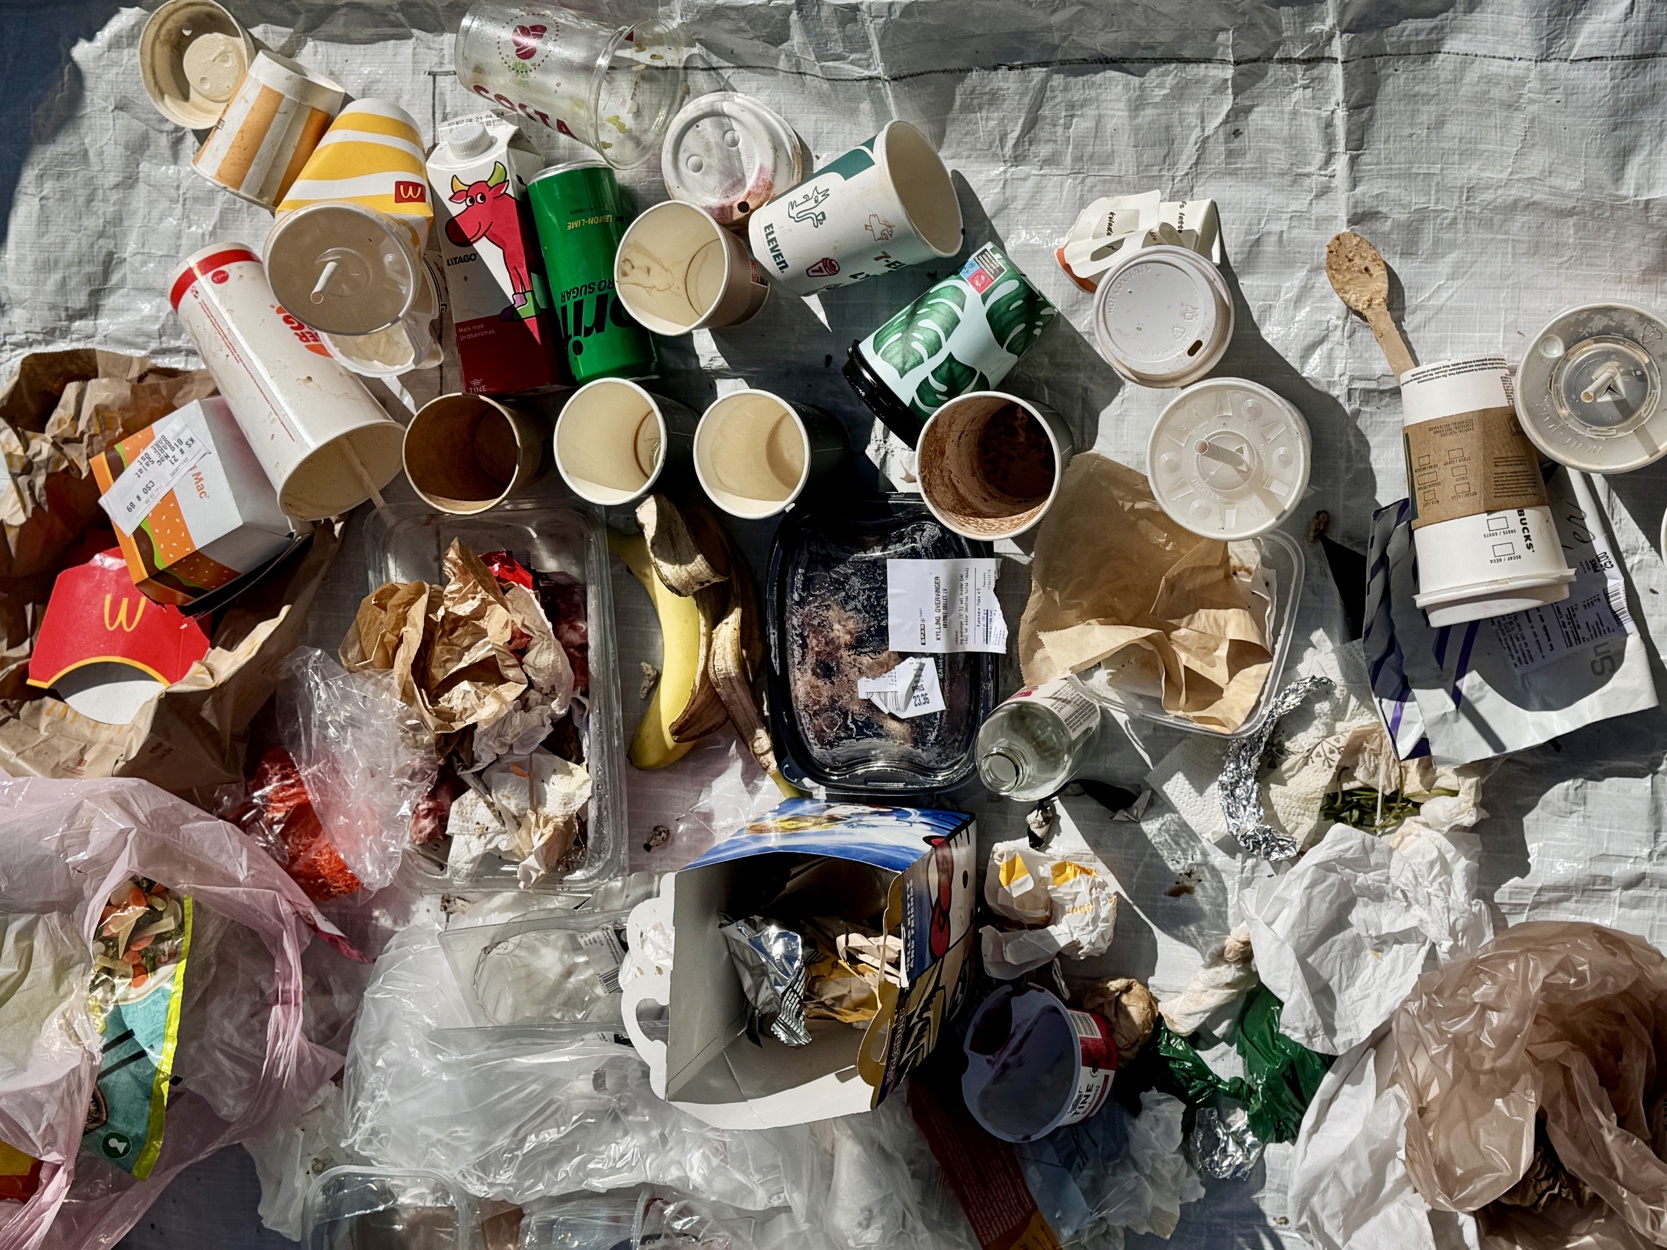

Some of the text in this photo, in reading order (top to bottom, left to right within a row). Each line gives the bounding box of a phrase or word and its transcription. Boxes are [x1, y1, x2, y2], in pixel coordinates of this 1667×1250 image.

[567, 214, 613, 230] LEMON-LIME
[447, 253, 477, 266] LITAGO
[560, 278, 614, 303] RO SUGAR
[468, 385, 487, 394] TINE
[136, 434, 168, 465] BARE Ost
[154, 440, 172, 457] BARE
[169, 438, 184, 452] Big
[184, 437, 196, 448] KS
[156, 453, 170, 466] Mac
[168, 455, 179, 465] 21
[133, 457, 156, 478] Salat
[140, 480, 156, 494] CSO
[191, 469, 210, 499] Mac
[135, 494, 142, 502] #
[1516, 508, 1536, 550] BUCKS
[1589, 558, 1600, 574] PRIS
[912, 681, 924, 692] PRIS
[1072, 1084, 1094, 1118] TINE
